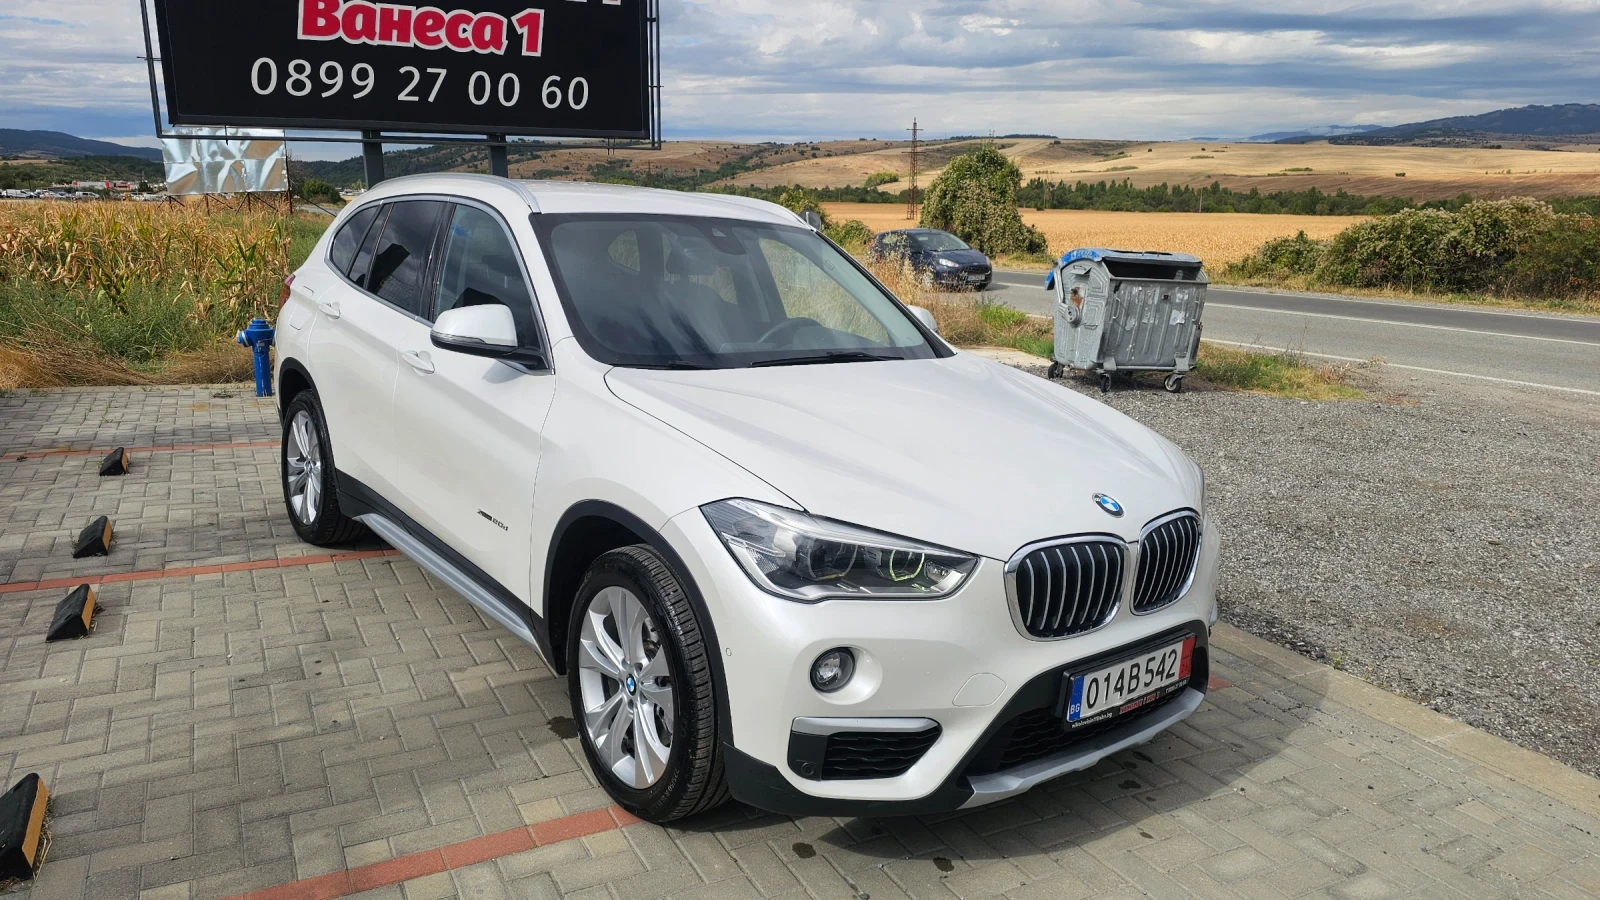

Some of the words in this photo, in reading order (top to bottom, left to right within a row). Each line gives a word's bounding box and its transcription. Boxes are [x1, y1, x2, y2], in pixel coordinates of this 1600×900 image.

[297, 0, 508, 55] Ванеса
[510, 8, 545, 57] 1
[251, 57, 374, 99] 0899
[398, 66, 446, 102] 27
[469, 71, 519, 106] 00
[542, 76, 588, 109] 60
[1086, 649, 1178, 709] 014B542
[1070, 703, 1080, 715] BG
